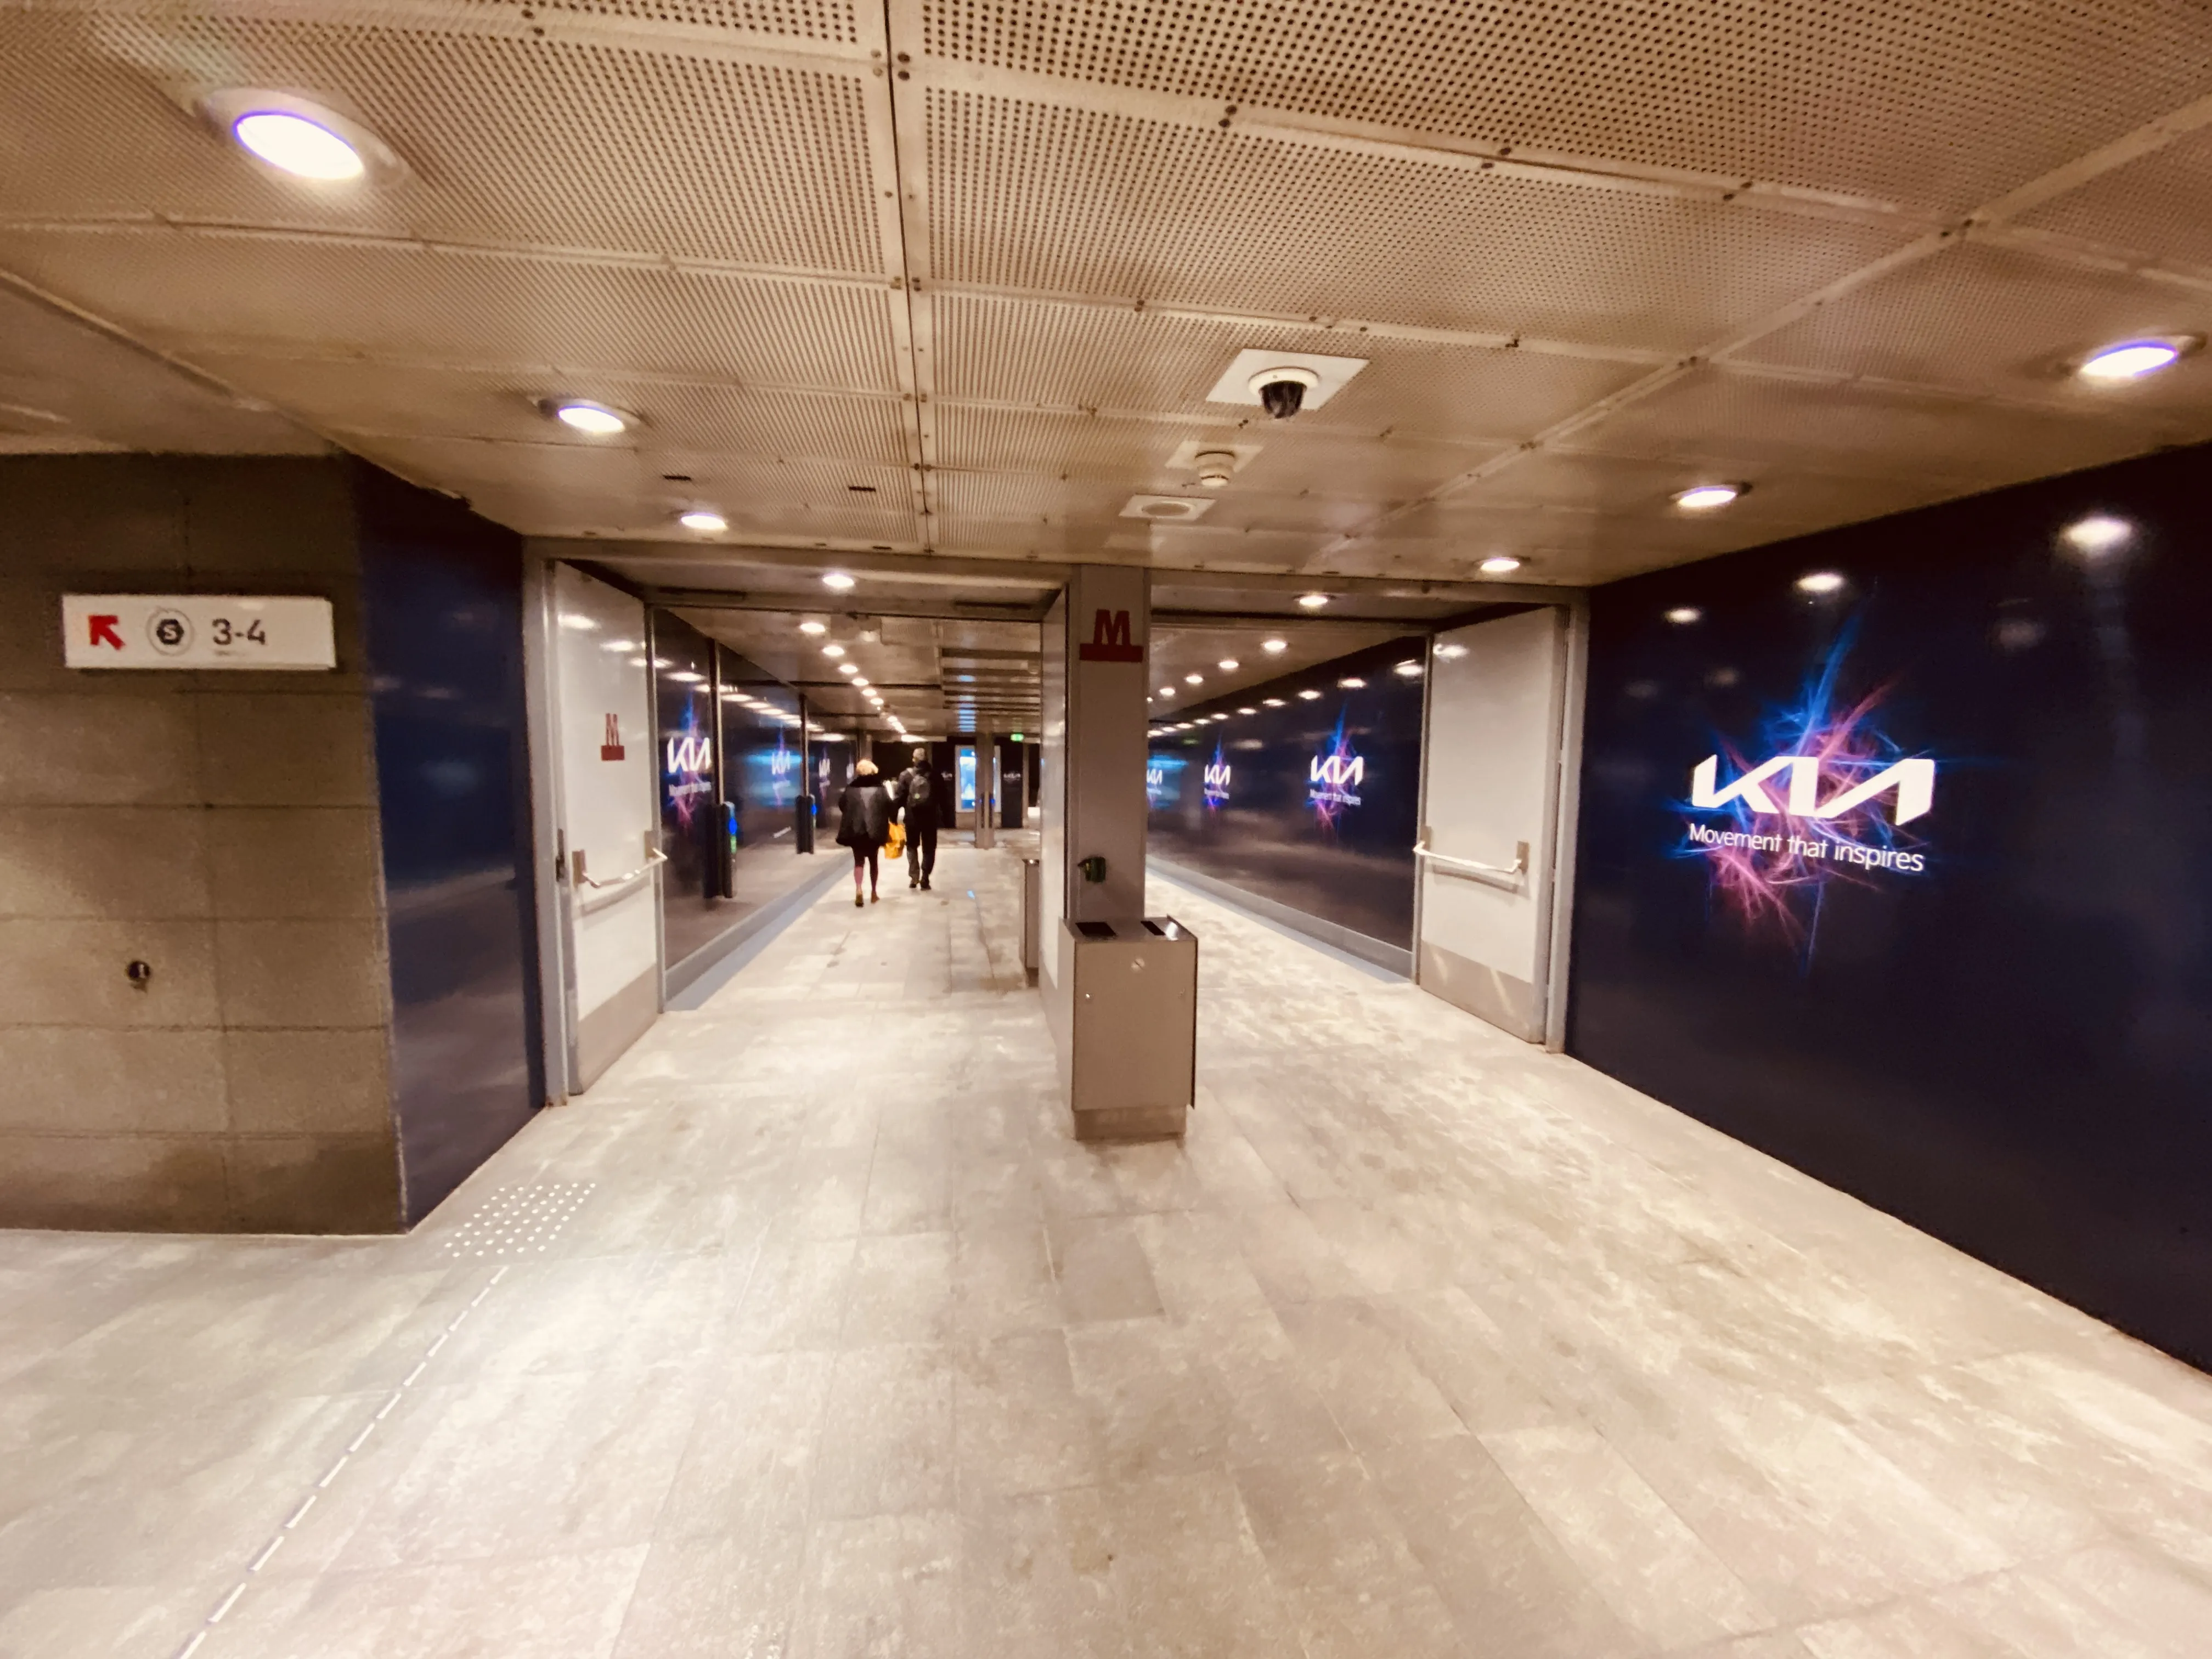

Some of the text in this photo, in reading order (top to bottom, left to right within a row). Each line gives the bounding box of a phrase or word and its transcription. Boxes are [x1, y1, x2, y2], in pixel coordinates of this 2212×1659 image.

[212, 618, 266, 645] 3-4
[1093, 609, 1130, 645] M
[1311, 755, 1364, 786] KIA
[1691, 754, 1936, 826] KIA
[1689, 823, 1925, 872] Movement that inspires
